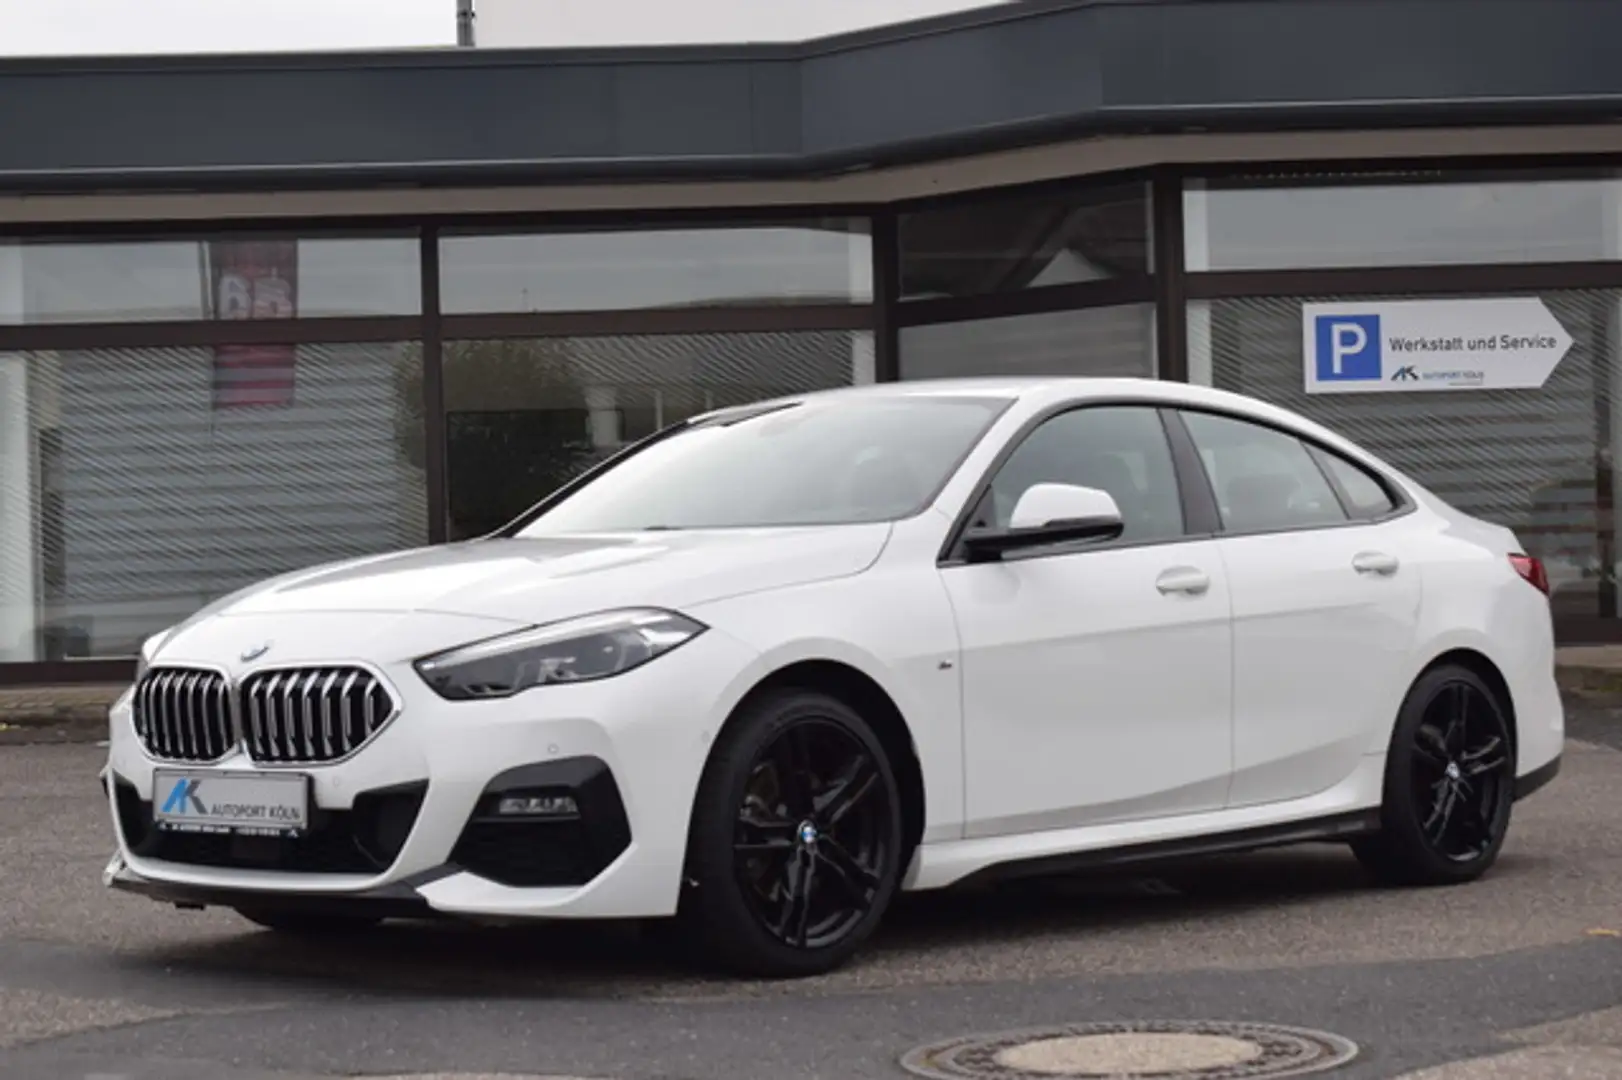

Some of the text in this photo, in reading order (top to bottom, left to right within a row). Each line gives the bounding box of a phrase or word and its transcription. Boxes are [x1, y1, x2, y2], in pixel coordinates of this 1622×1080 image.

[1331, 322, 1368, 375] P
[1389, 334, 1557, 352] Werkstatt und Service
[211, 803, 301, 820] AUTOPORT KÖLN
